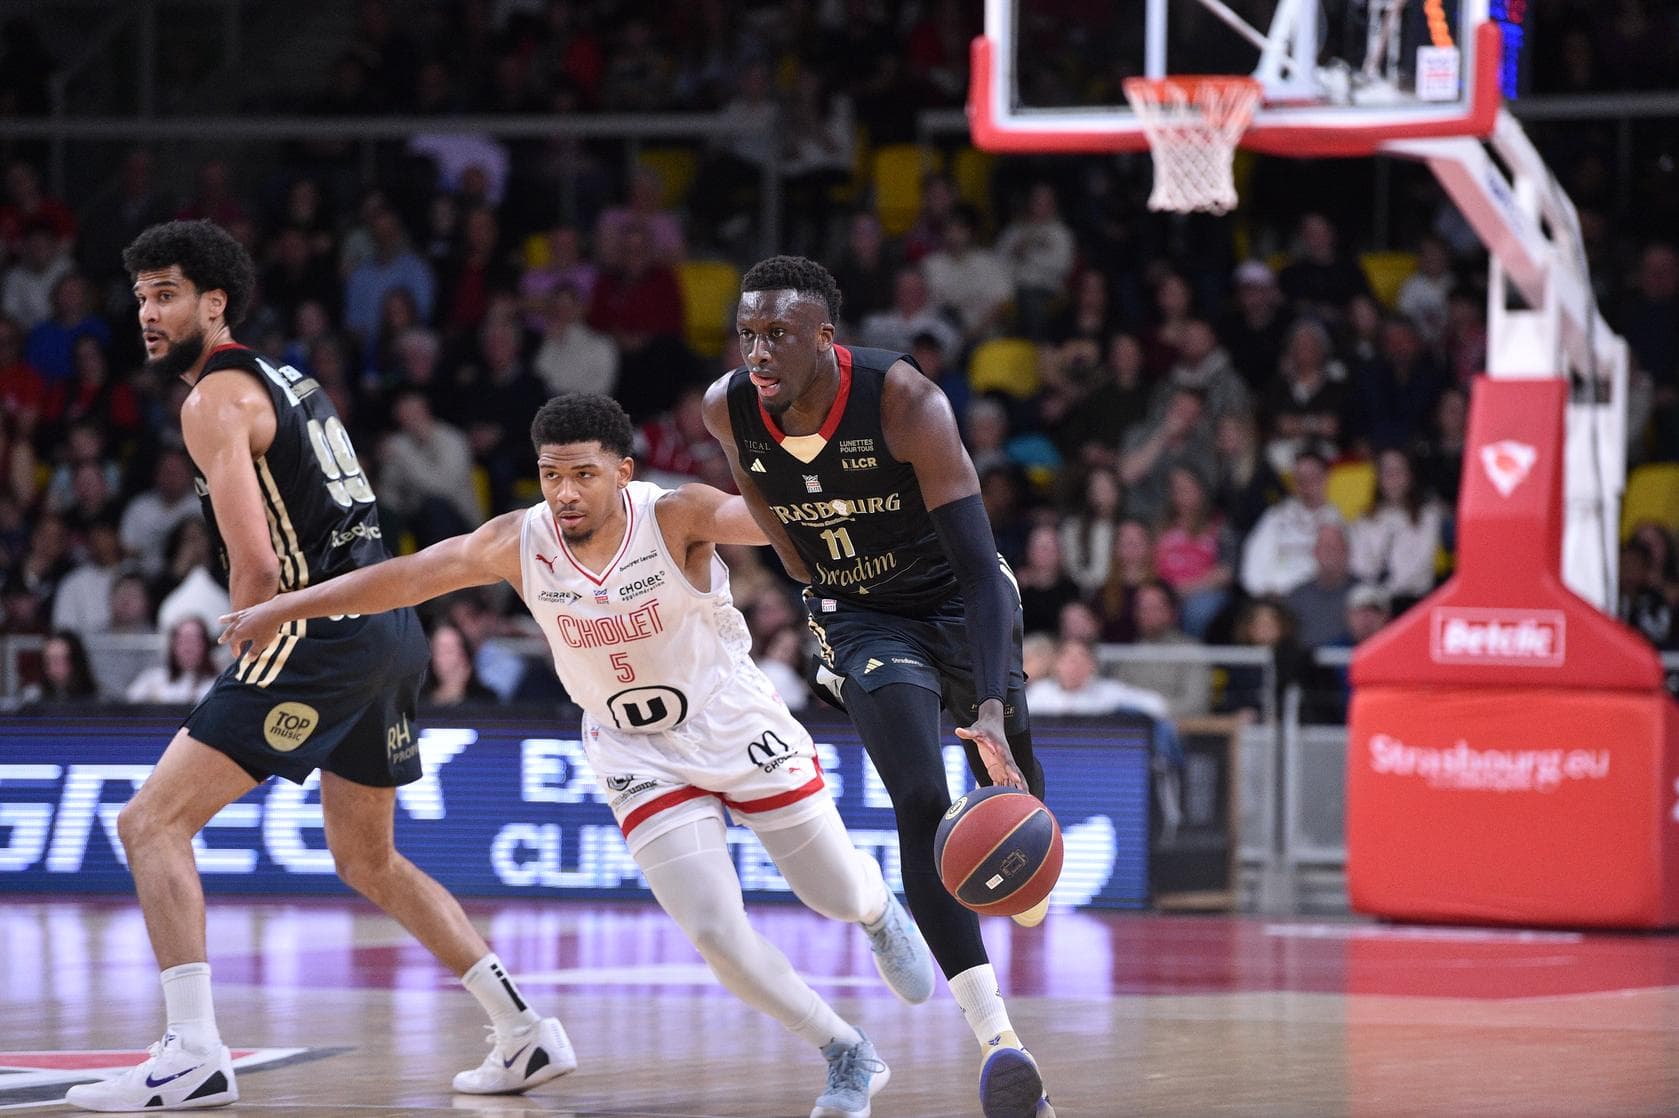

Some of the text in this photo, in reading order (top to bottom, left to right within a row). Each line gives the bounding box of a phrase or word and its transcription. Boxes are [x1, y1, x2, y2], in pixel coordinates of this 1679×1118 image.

[840, 438, 874, 447] LUNETTES
[819, 527, 856, 561] 11
[556, 598, 664, 649] CHOLET
[608, 651, 636, 684] 5
[275, 711, 311, 731] TOP
[622, 696, 669, 728] U
[270, 726, 302, 741] music
